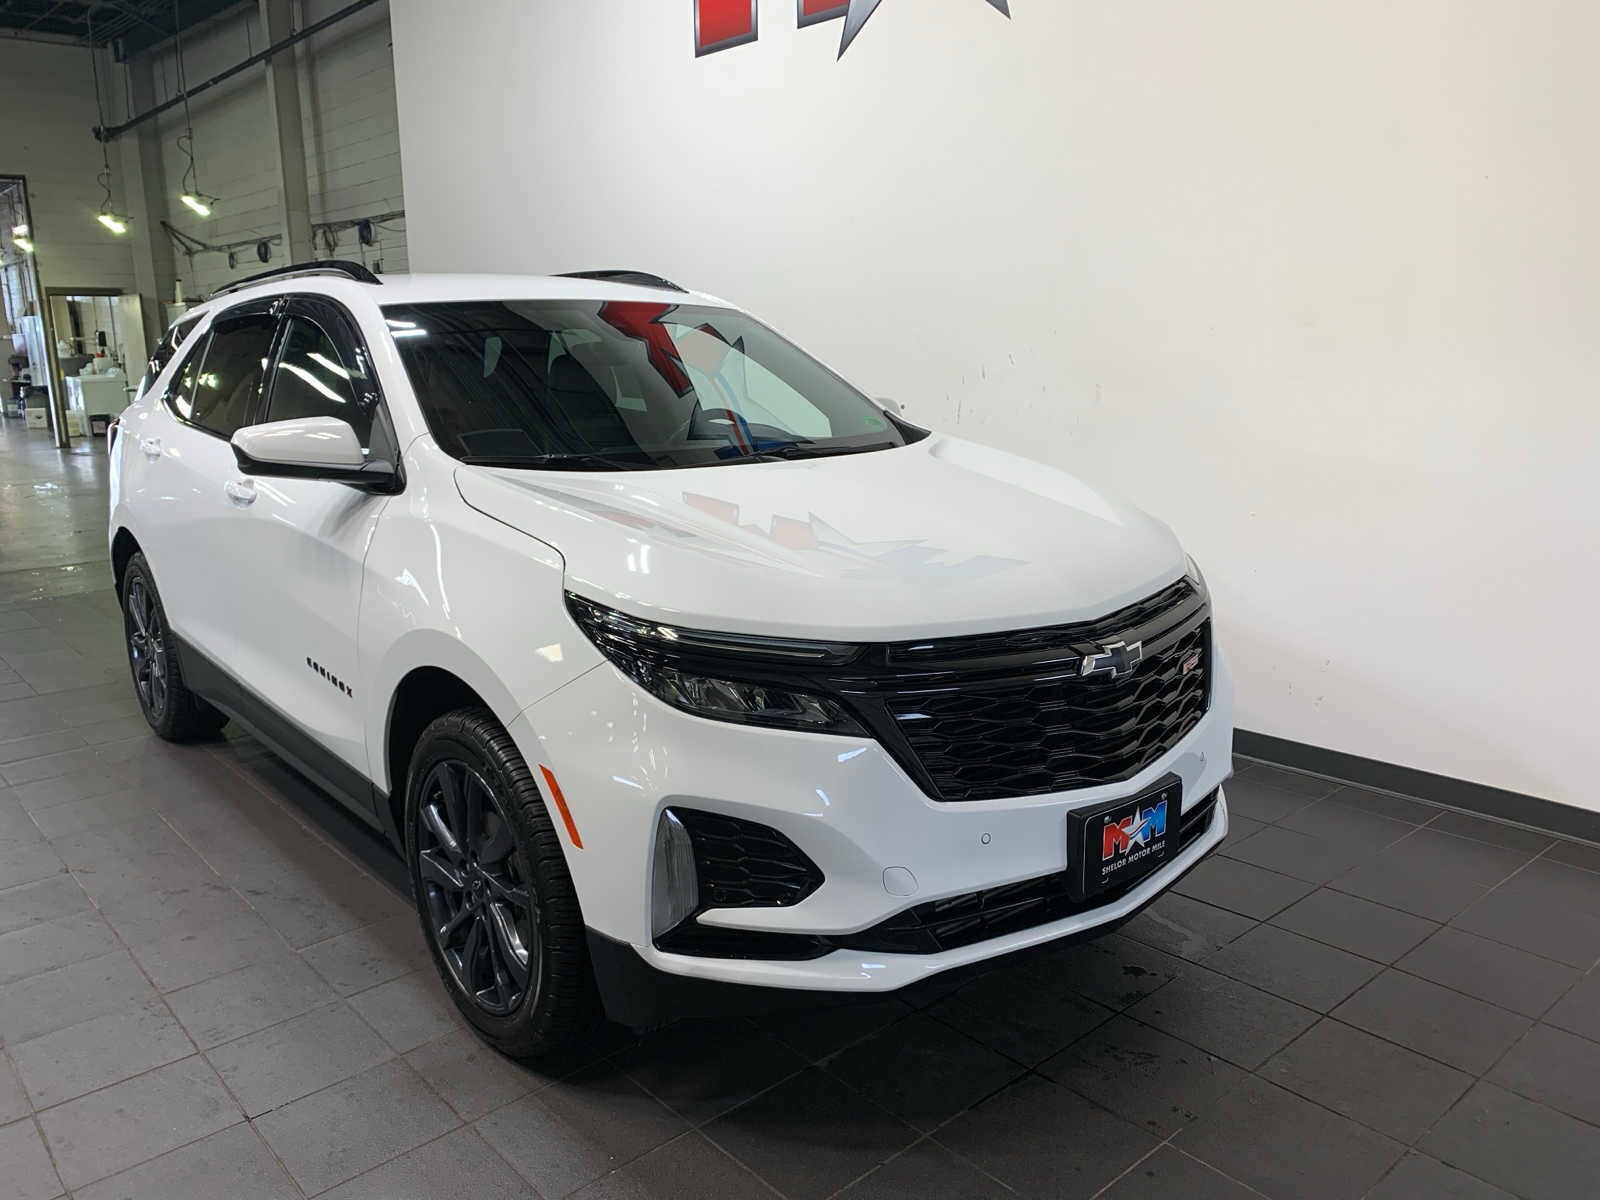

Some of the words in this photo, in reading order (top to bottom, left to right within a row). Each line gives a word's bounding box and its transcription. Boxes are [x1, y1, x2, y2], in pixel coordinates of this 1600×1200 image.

[306, 656, 353, 699] EQUINOX
[1102, 858, 1127, 876] SHELOR
[1128, 847, 1151, 864] MOTOR
[1151, 840, 1166, 853] MILE
